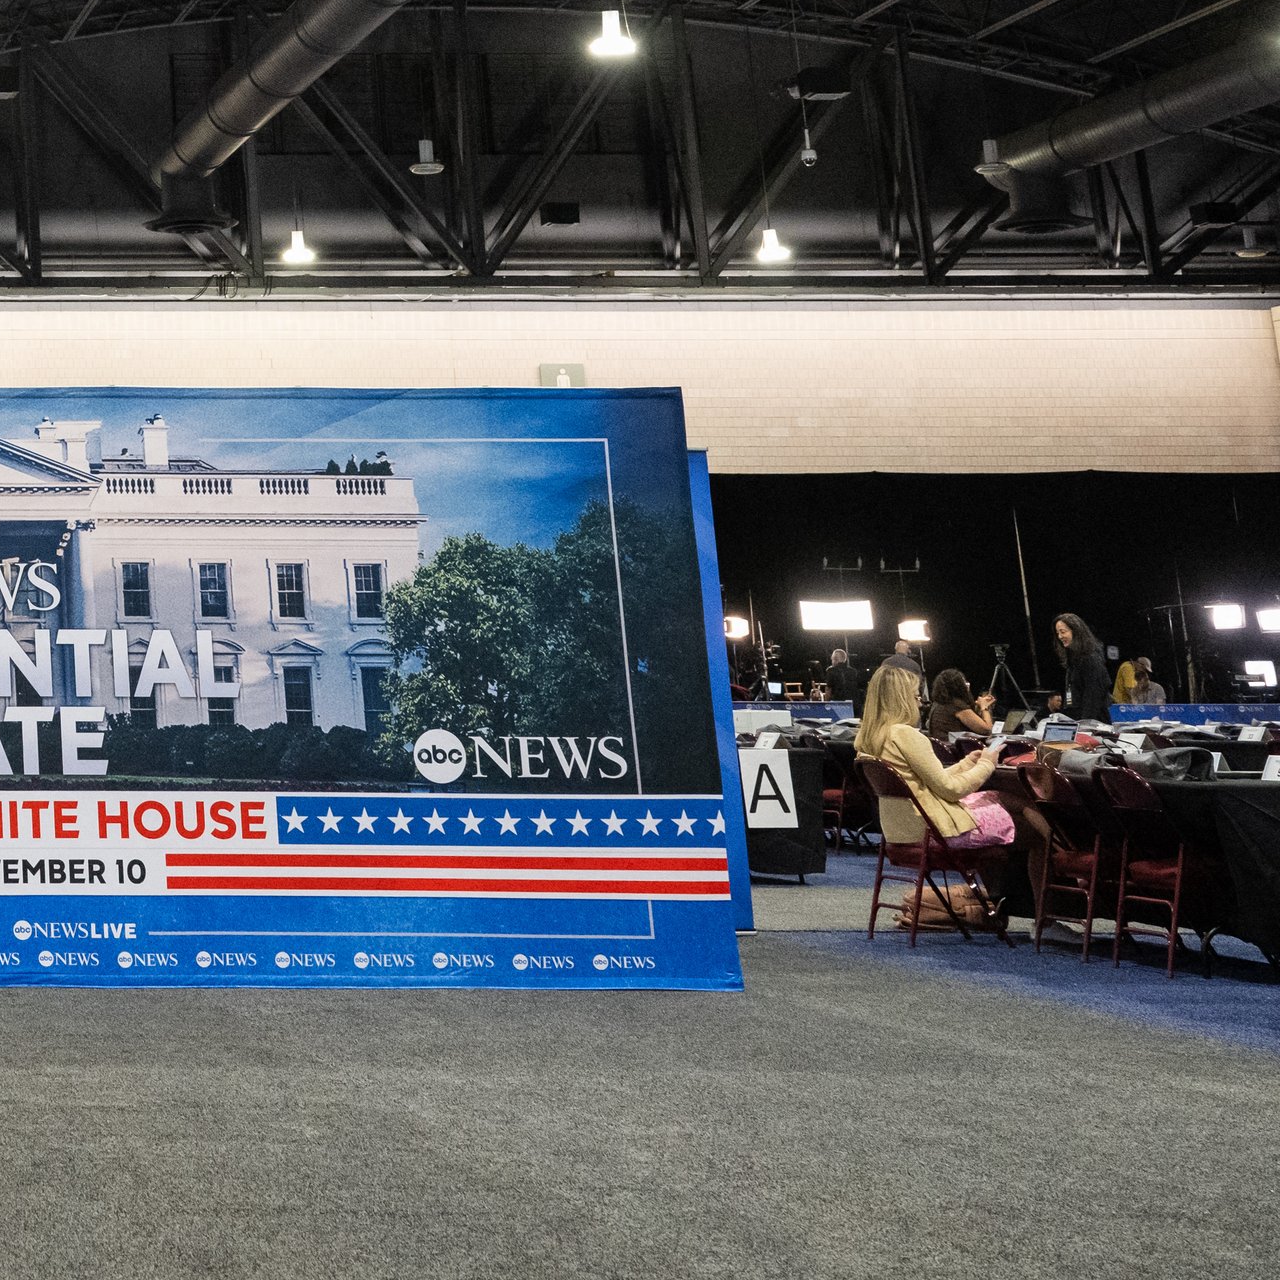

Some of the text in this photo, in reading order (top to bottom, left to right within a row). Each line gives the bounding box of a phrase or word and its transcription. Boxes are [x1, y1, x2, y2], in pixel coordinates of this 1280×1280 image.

[416, 736, 628, 779] abc NEWS
[750, 763, 791, 814] A
[97, 800, 268, 841] HOUSE
[115, 859, 147, 885] 10
[55, 952, 100, 967] NEWS
[134, 952, 178, 967] NEWS
[212, 952, 257, 967] NEWS
[291, 953, 336, 967] NEWS
[370, 953, 415, 968] NEWS
[449, 954, 494, 968] NEWS
[529, 954, 574, 969] NEWS
[609, 955, 656, 970] NEWS
